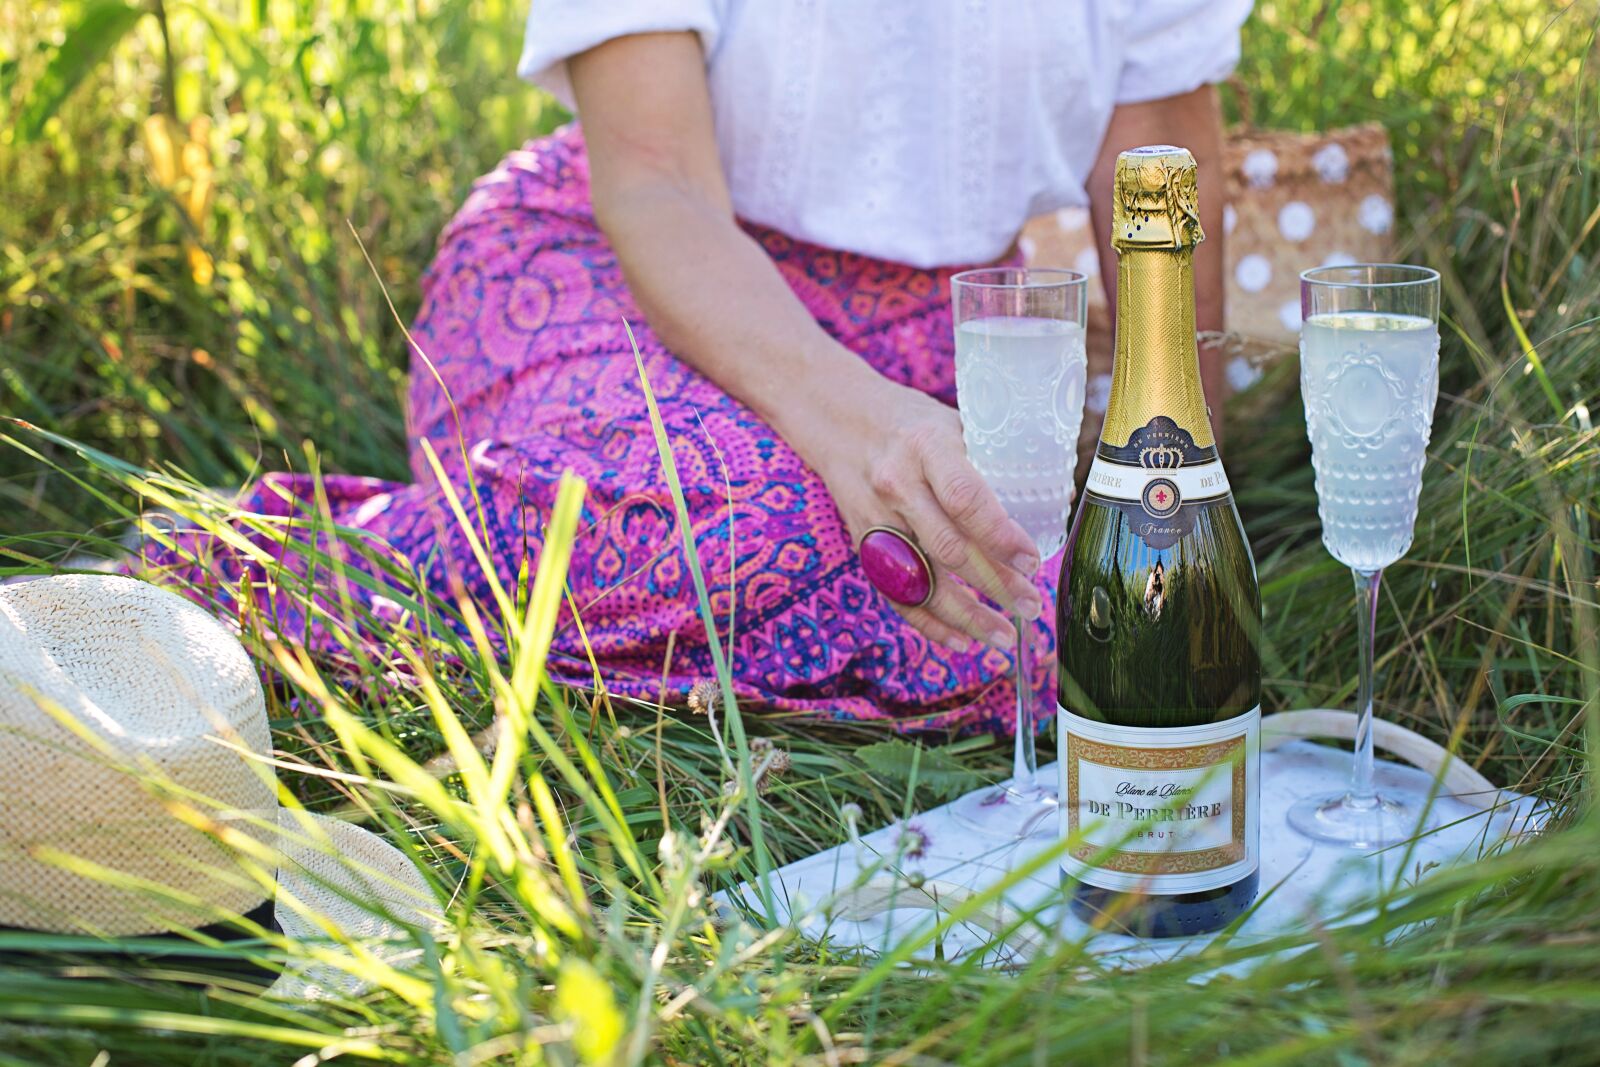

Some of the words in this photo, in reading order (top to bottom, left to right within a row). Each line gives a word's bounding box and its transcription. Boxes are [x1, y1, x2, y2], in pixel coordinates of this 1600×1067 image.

[1133, 438, 1143, 448] DE
[1200, 476, 1213, 488] DE
[1139, 522, 1182, 536] France
[1115, 781, 1146, 797] Blanc
[1146, 785, 1159, 796] de
[1088, 799, 1110, 817] DE
[1137, 831, 1174, 839] BRUT
